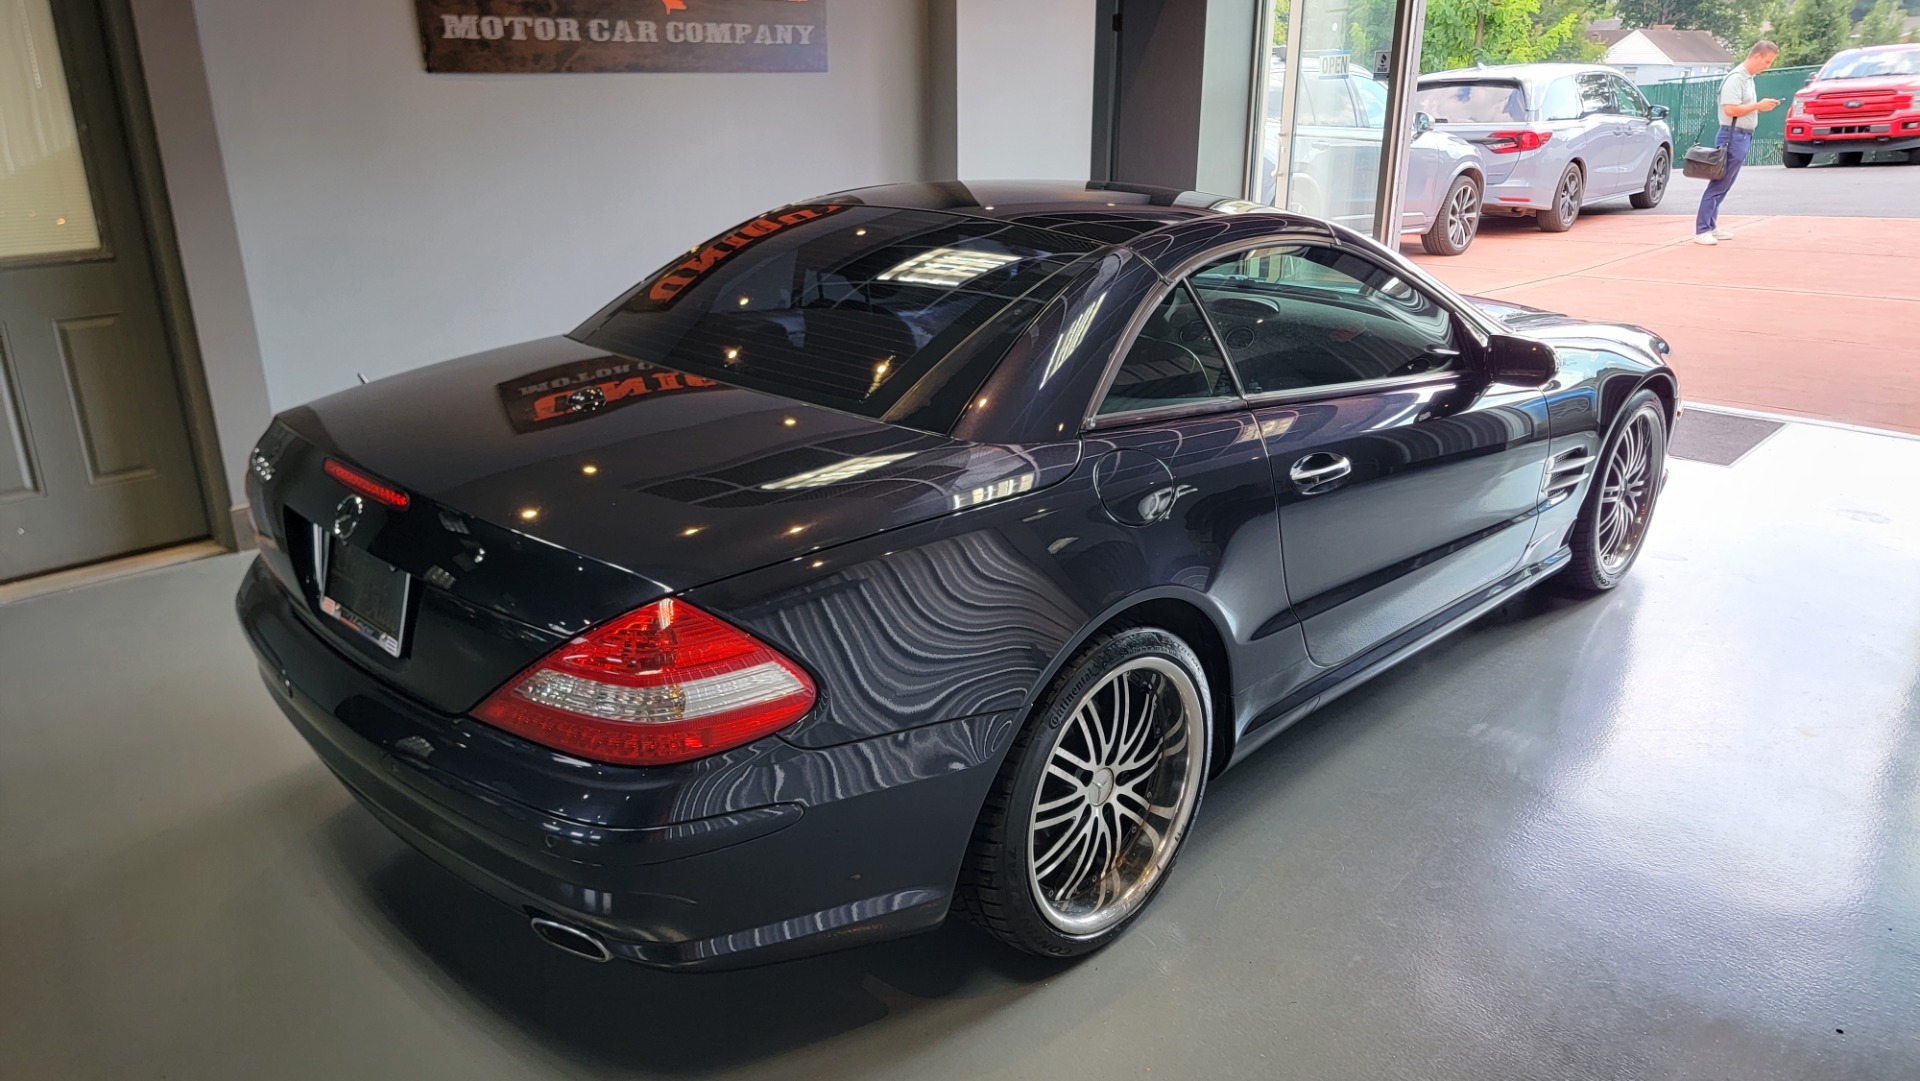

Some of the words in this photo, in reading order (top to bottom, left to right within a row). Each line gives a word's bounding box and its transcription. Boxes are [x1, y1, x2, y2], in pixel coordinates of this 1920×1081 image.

[440, 13, 582, 42] MOTOR
[588, 18, 659, 43] CAR
[666, 21, 816, 45] COMPANY
[1322, 55, 1348, 74] OPEN
[1048, 664, 1098, 731] Continental
